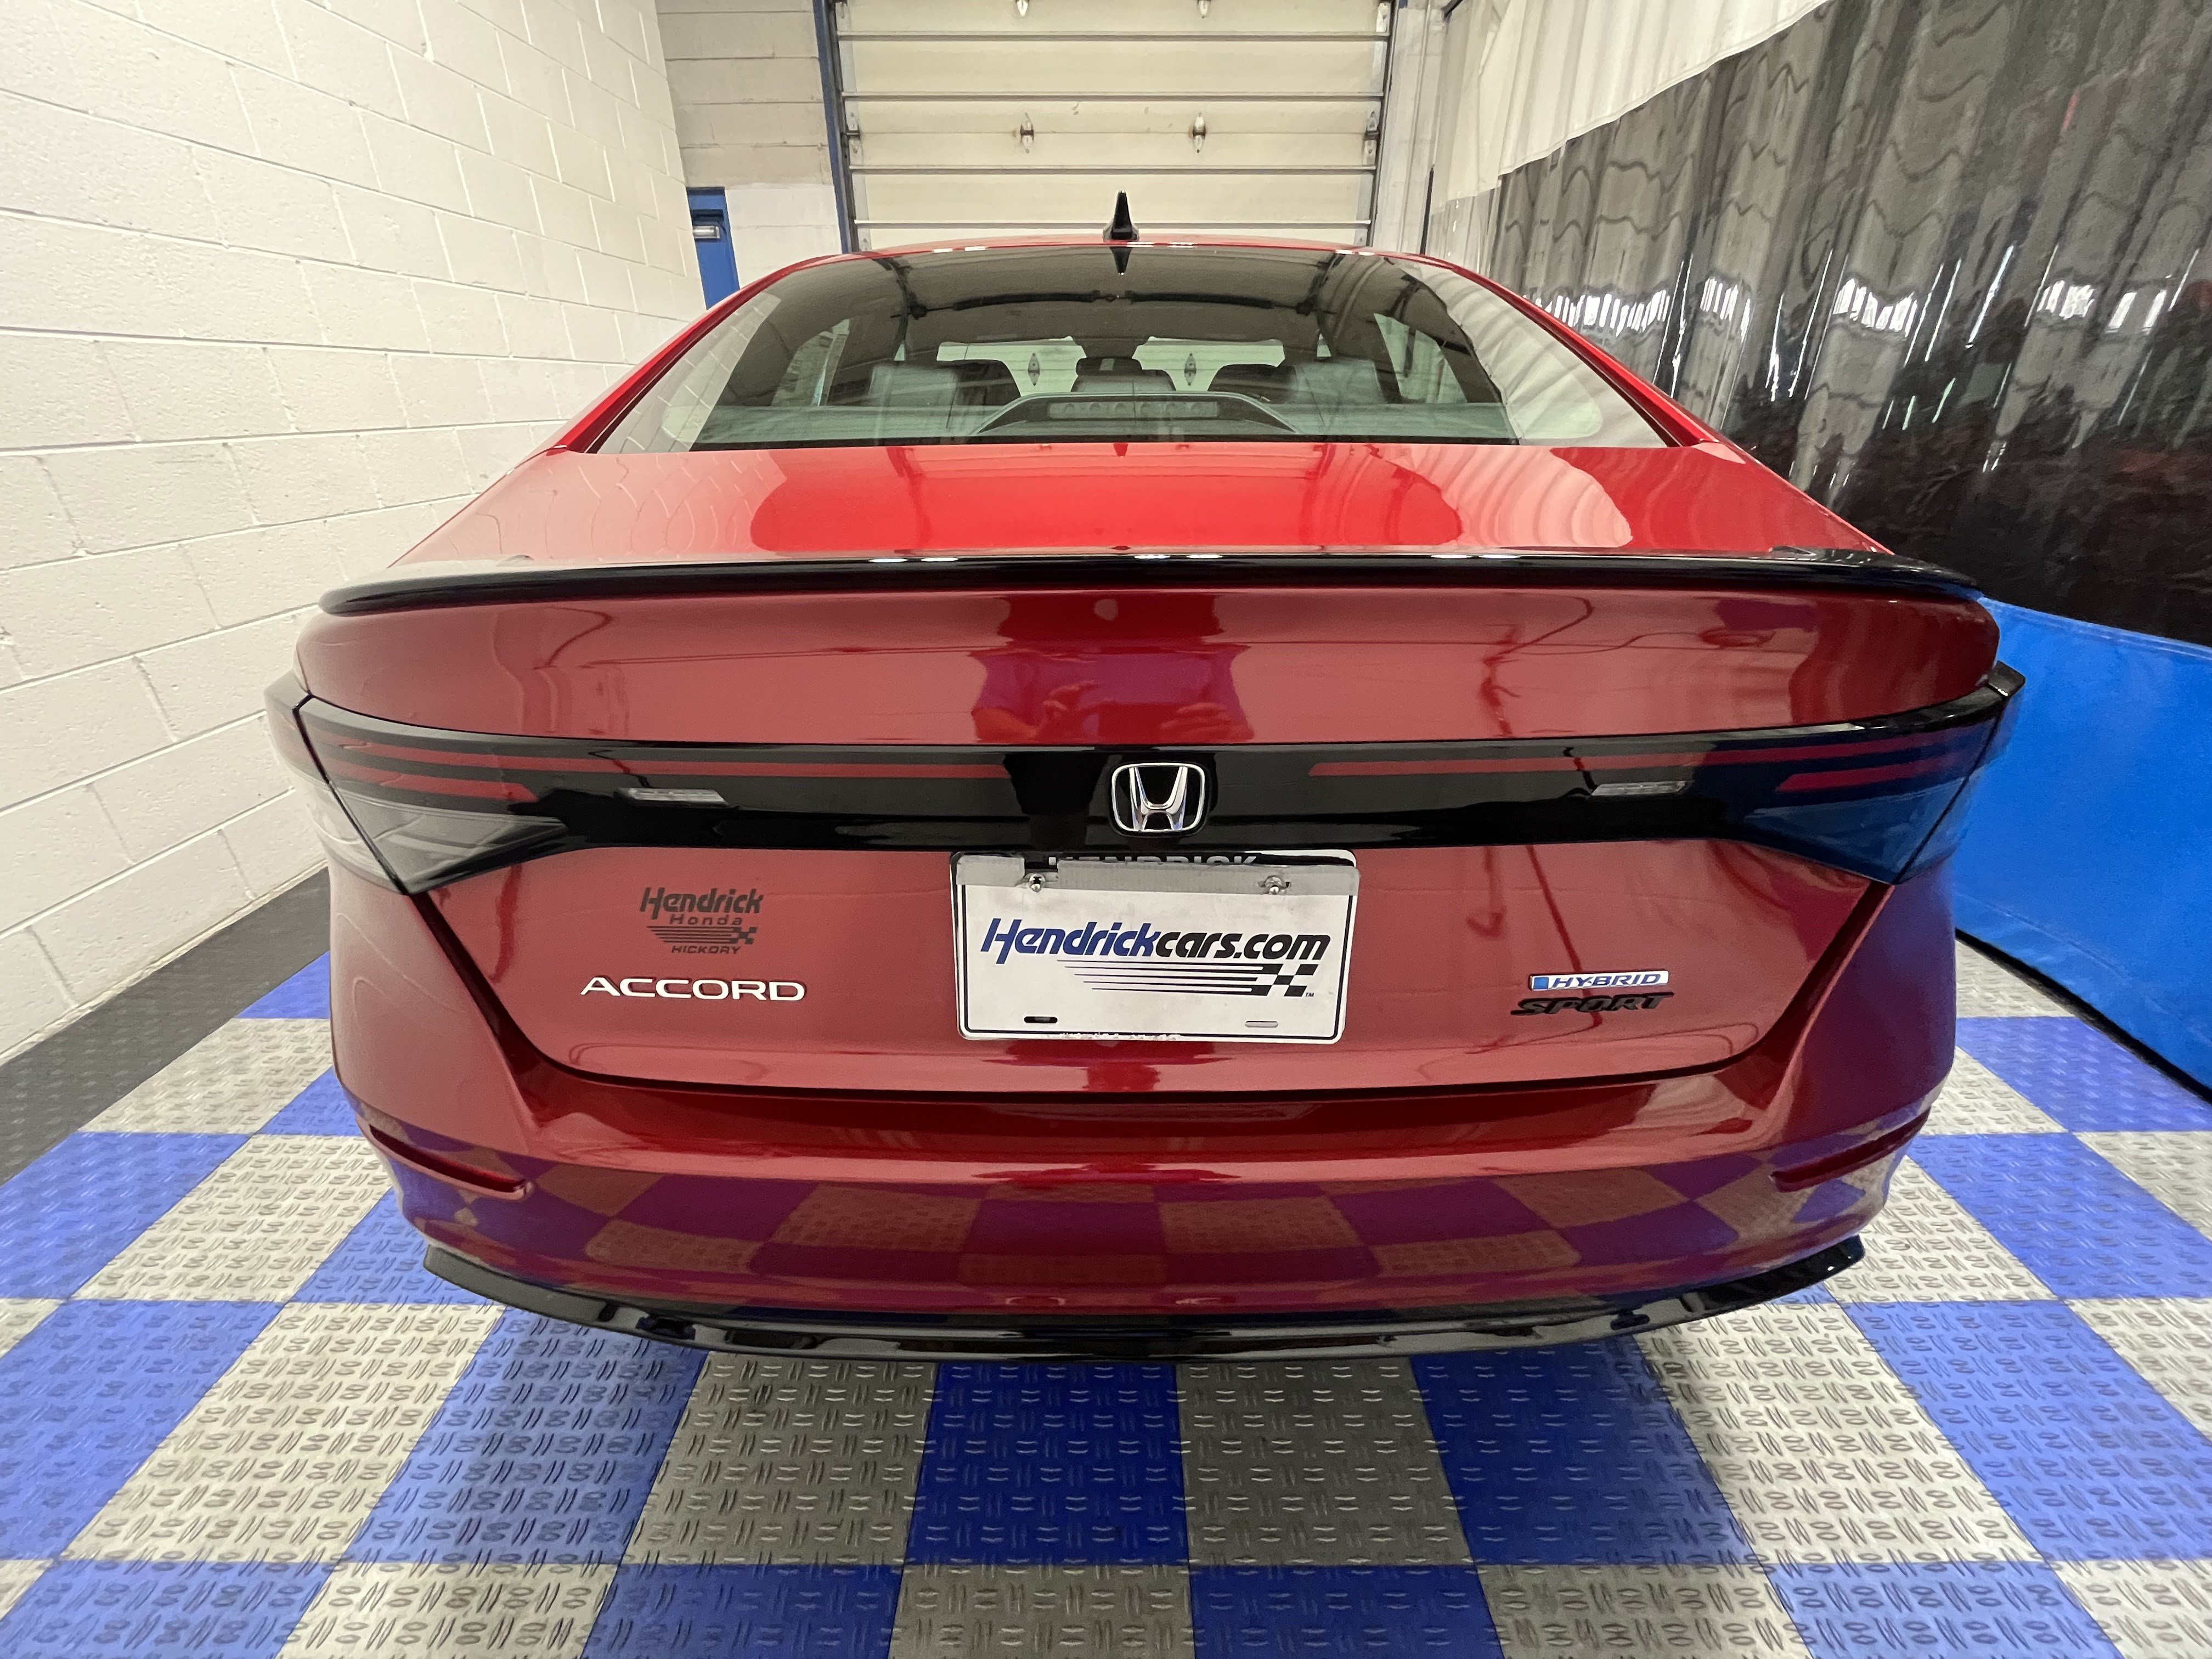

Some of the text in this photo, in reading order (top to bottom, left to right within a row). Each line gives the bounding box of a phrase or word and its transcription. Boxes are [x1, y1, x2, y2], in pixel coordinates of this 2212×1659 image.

[640, 887, 764, 919] Hendrick
[669, 913, 742, 925] Honda
[671, 945, 741, 954] HICKORY
[980, 918, 1331, 964] Hendrickcars.com
[580, 977, 806, 1001] ACCORD
[1551, 973, 1661, 989] HYBRID
[1510, 991, 1674, 1015] SPORT
